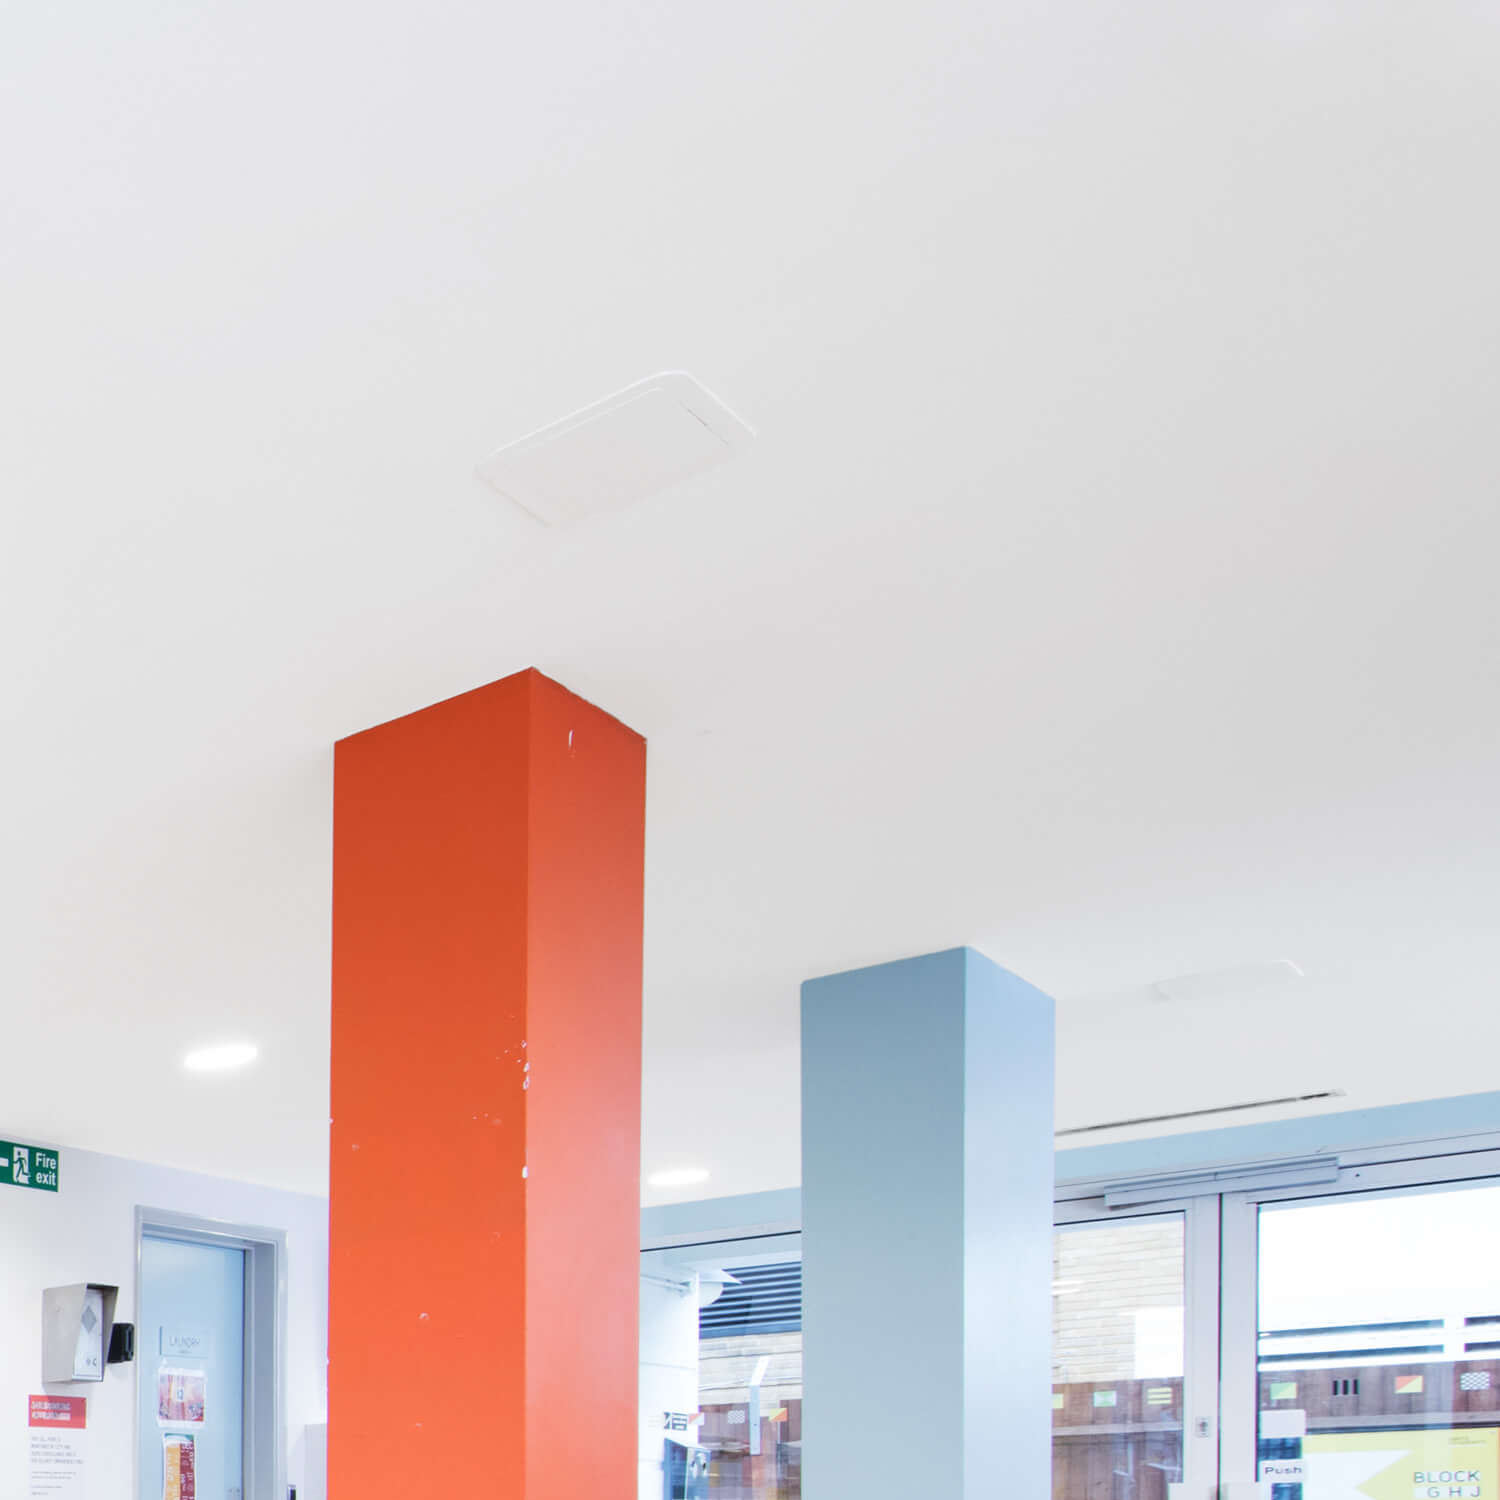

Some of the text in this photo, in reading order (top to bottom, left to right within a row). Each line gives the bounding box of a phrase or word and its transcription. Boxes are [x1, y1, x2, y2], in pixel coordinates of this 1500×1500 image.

[35, 1151, 57, 1171] Fire
[35, 1169, 57, 1187] exit
[1264, 1465, 1302, 1475] Push
[1413, 1470, 1480, 1484] BLOCK
[1427, 1486, 1481, 1498] G H J
